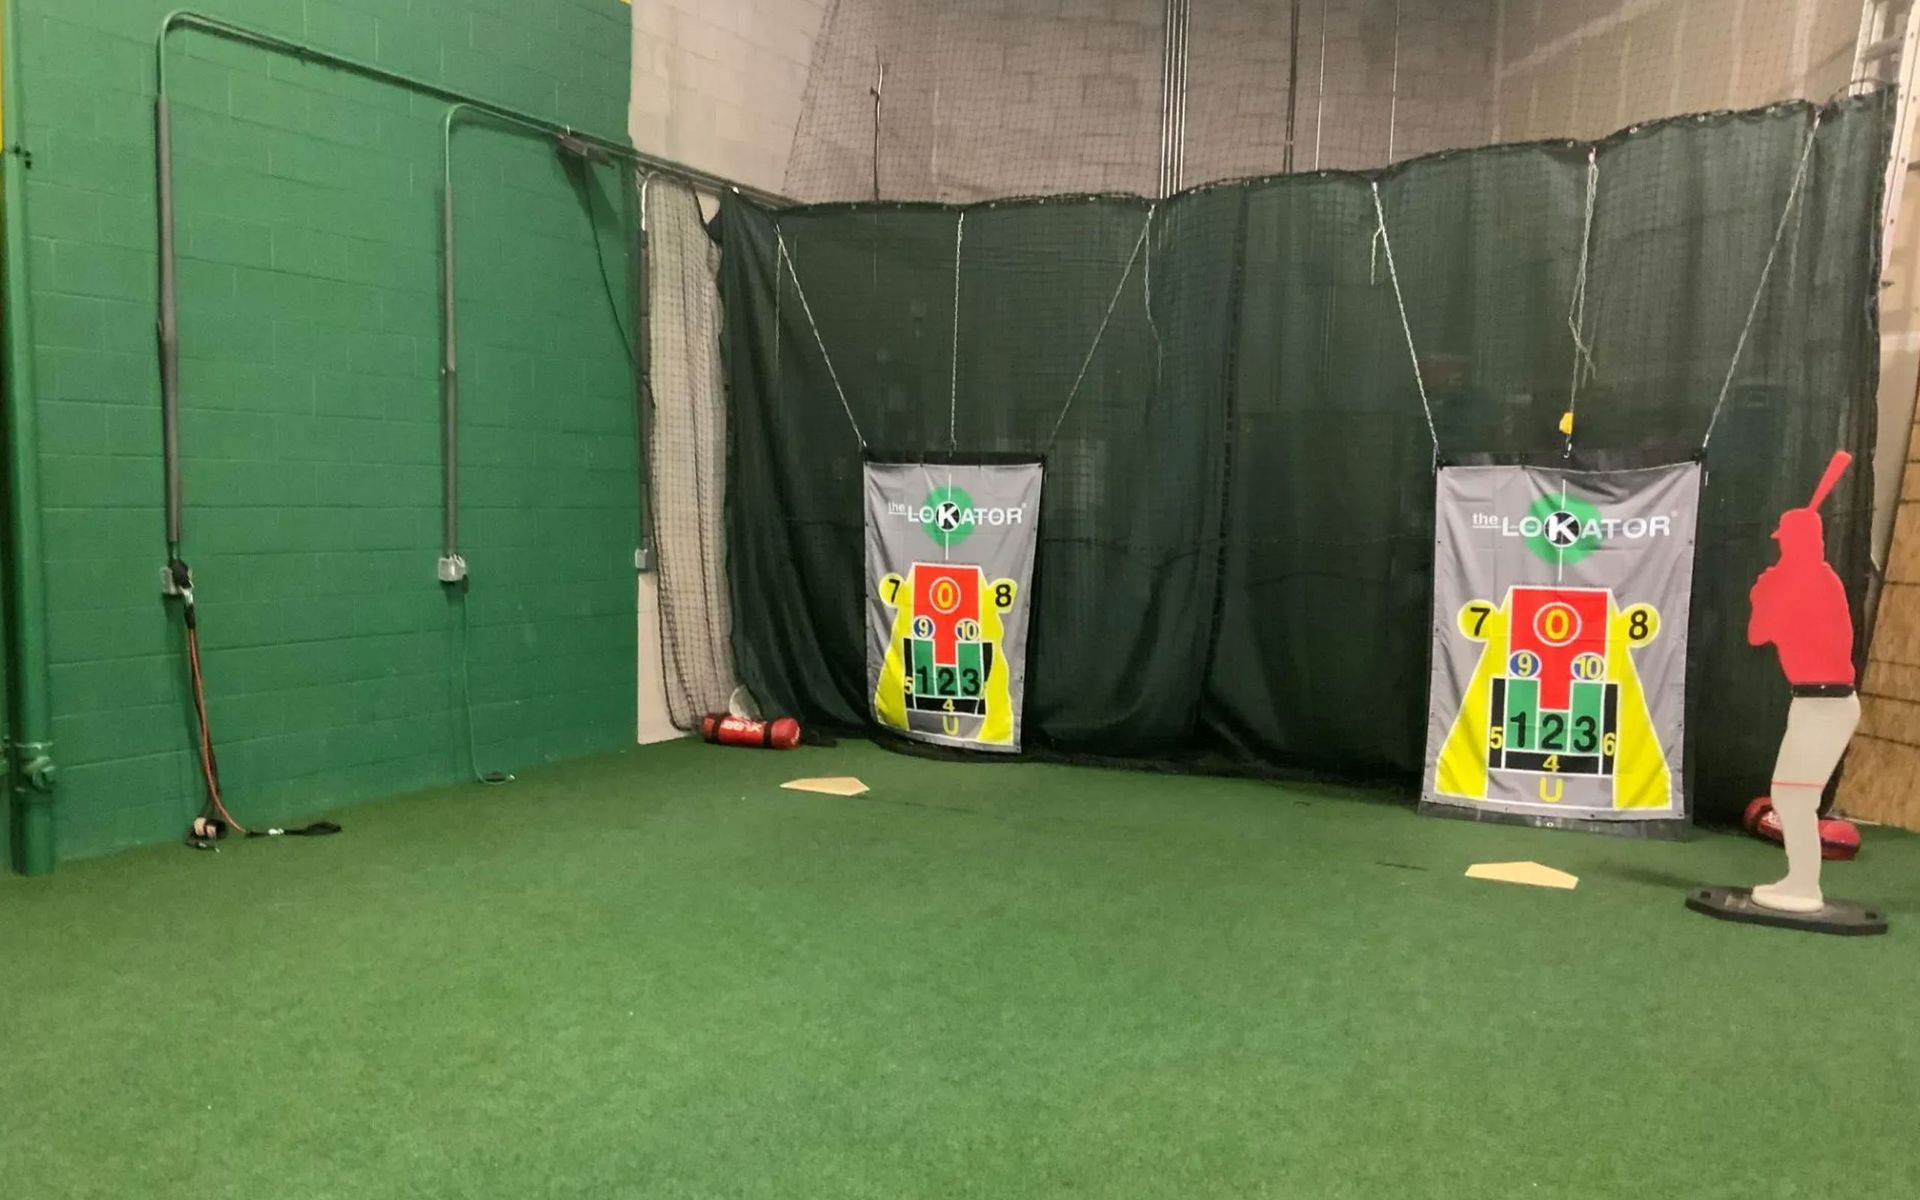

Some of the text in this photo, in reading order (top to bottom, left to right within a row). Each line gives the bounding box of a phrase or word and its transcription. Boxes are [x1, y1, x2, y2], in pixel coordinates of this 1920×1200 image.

[888, 502, 905, 512] the
[1472, 512, 1498, 525] the
[888, 578, 901, 603] 7
[937, 582, 953, 607] 0
[995, 584, 1012, 608] 8
[918, 618, 930, 638] 9
[959, 621, 978, 639] 10
[1469, 607, 1491, 637] 7
[1545, 609, 1569, 640] 0
[1628, 609, 1649, 641] 8
[1517, 653, 1533, 676] 9
[1577, 655, 1602, 678] 10
[904, 676, 913, 695] 5
[916, 666, 928, 694] 1
[938, 668, 955, 696] 2
[962, 668, 980, 695] 3
[943, 697, 955, 713] 4
[943, 715, 959, 736] U
[1510, 711, 1597, 752] 1 2 3
[1490, 726, 1502, 749] 5
[1603, 732, 1616, 756] 6
[1542, 753, 1560, 773] 4
[1539, 778, 1563, 803] U
